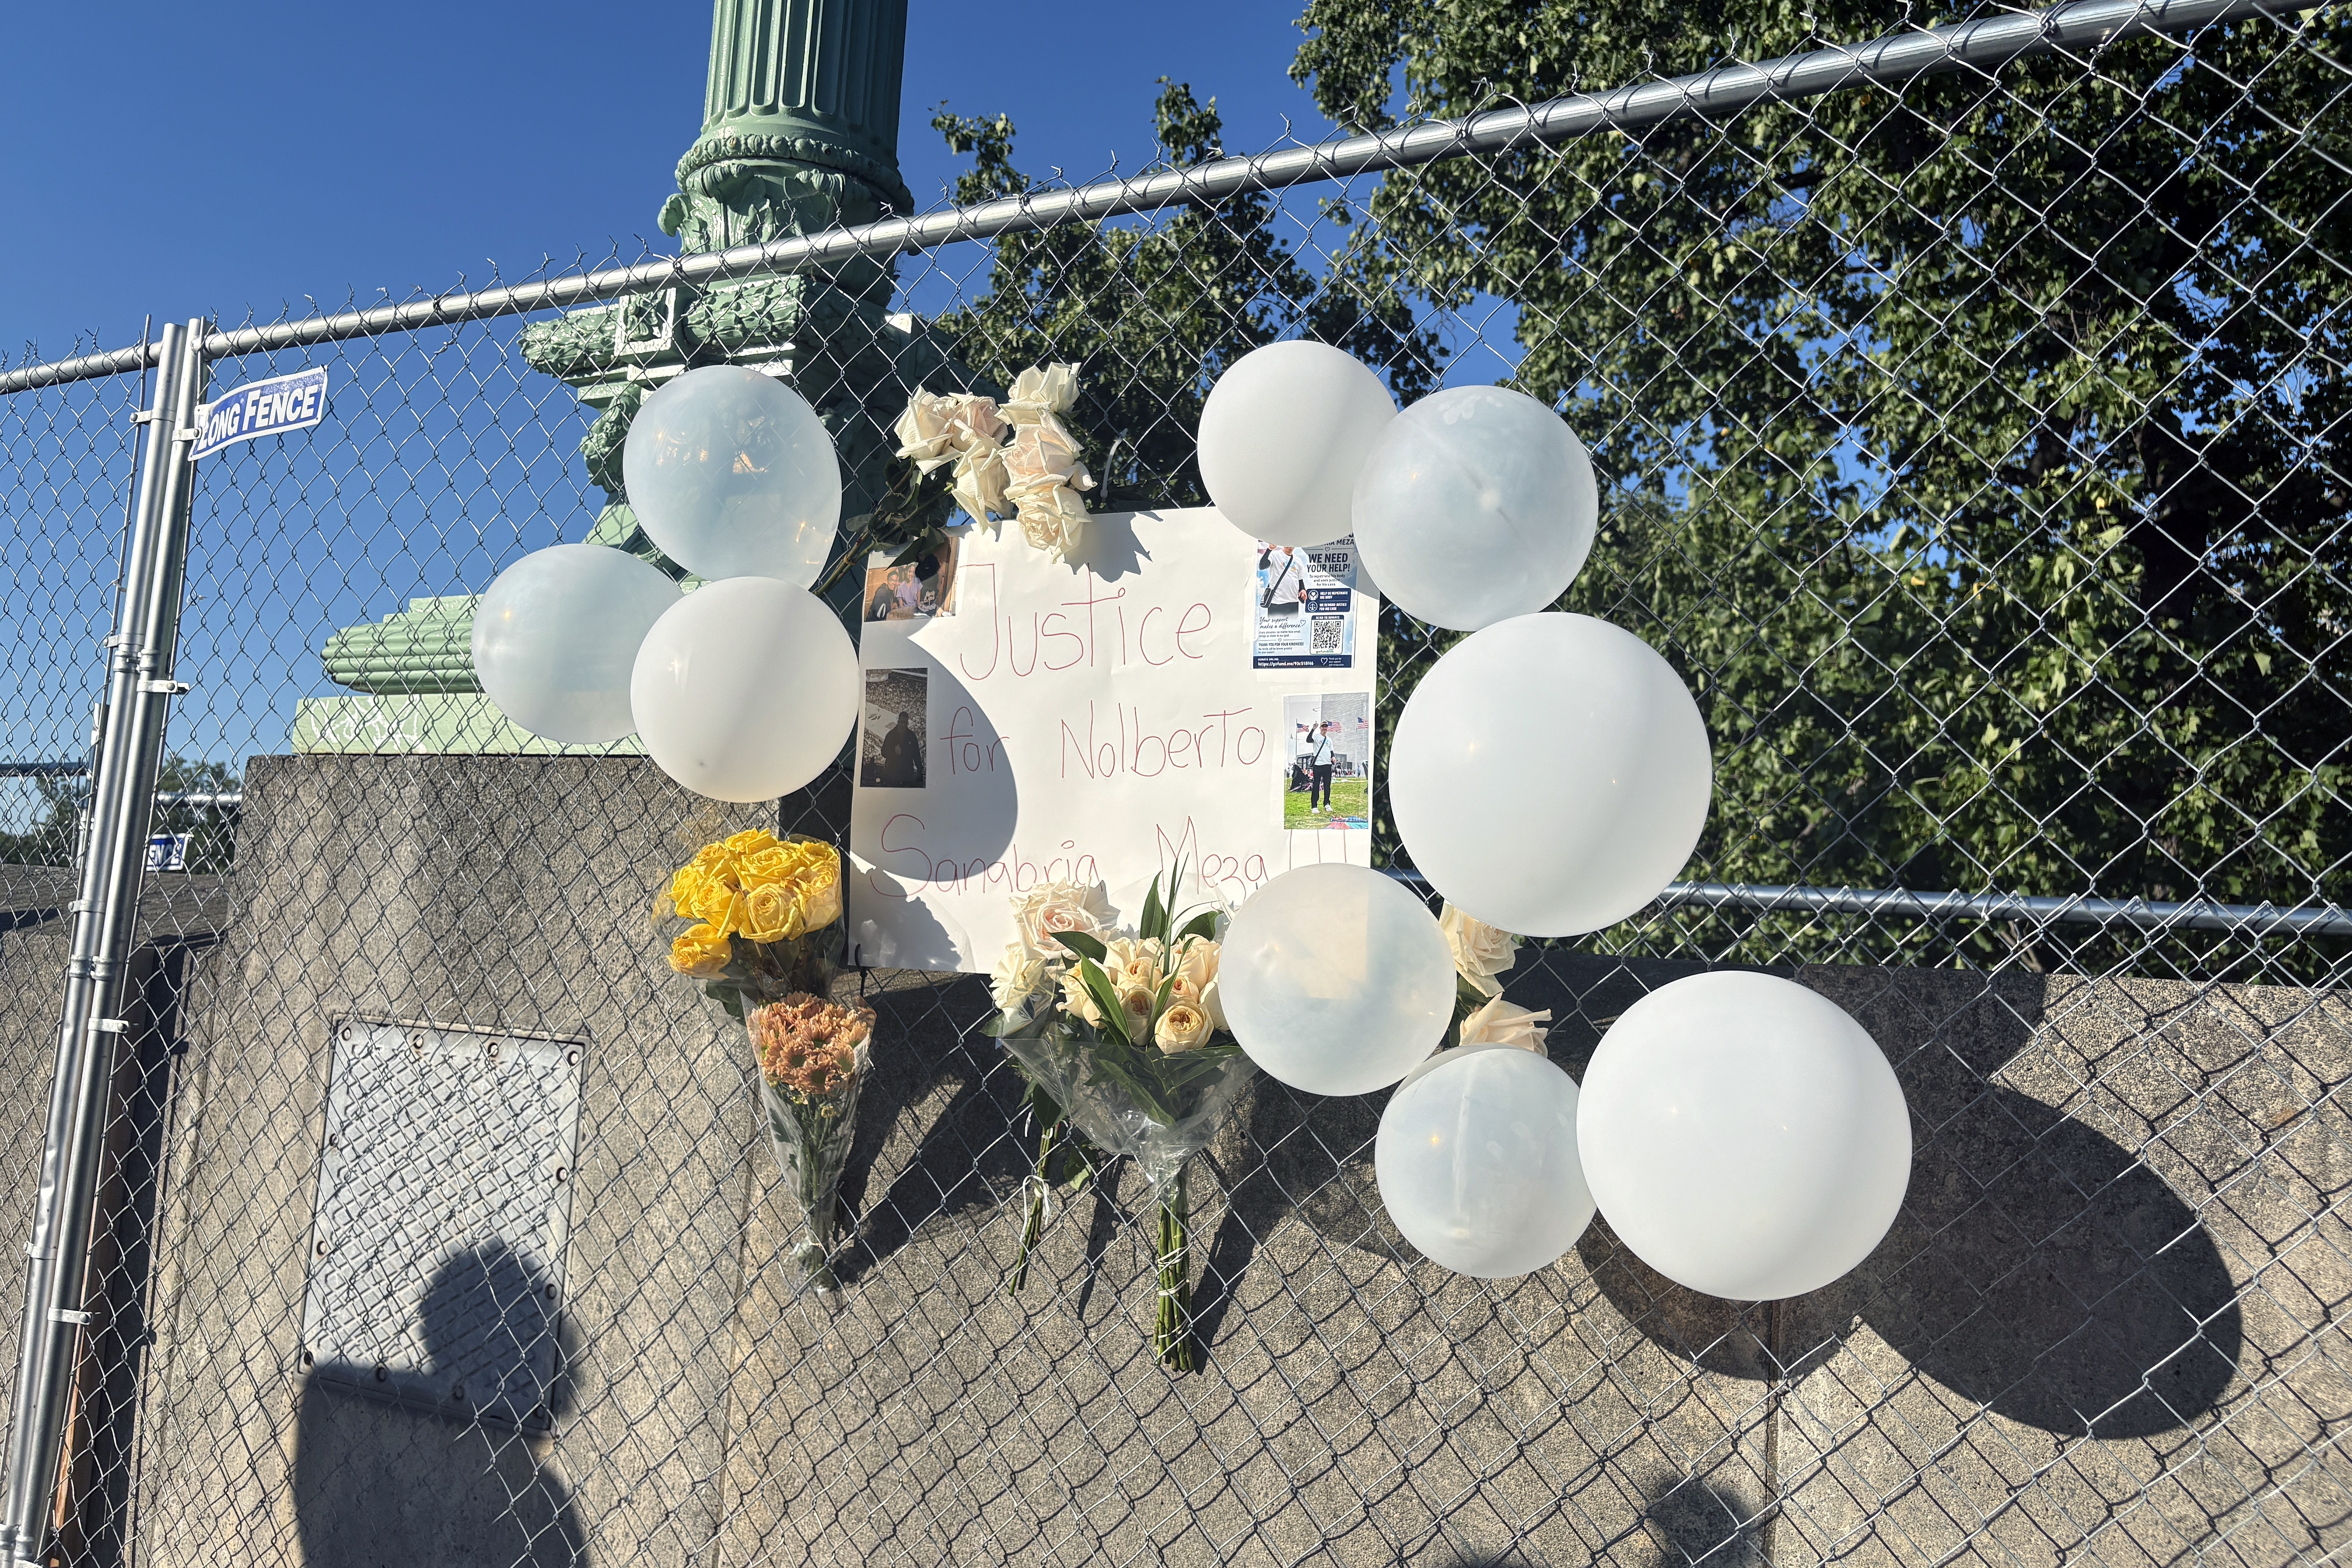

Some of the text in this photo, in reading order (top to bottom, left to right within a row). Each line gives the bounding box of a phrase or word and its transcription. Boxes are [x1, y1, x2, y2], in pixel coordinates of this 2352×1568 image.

[197, 385, 318, 451] LONG FENCE
[1307, 563, 1350, 572] YOUR HELP!
[1308, 553, 1348, 563] WE NEED
[959, 562, 1211, 680] Justice
[940, 707, 1010, 775] for
[870, 814, 1103, 898] Sanabria
